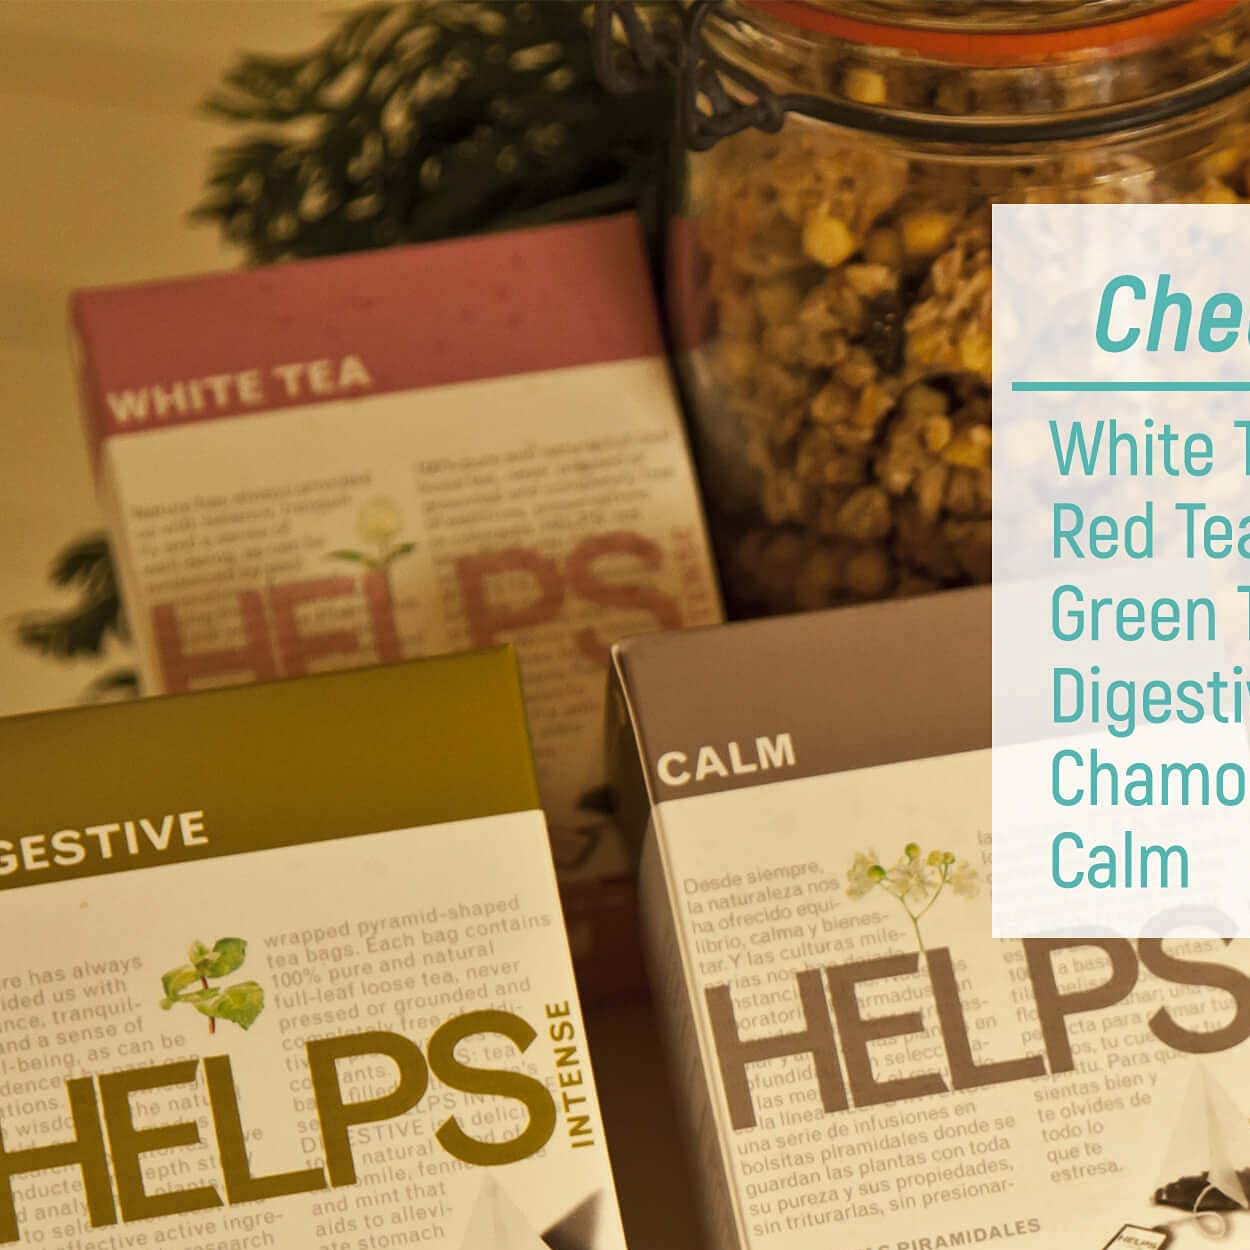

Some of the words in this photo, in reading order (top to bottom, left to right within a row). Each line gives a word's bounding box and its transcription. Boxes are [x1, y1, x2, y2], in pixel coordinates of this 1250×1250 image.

[107, 374, 263, 426] WHITE
[275, 355, 374, 396] TEA
[656, 734, 796, 789] CALM
[683, 872, 743, 895] Desde
[747, 861, 824, 884] siempre,
[708, 885, 803, 913] naturaleza
[808, 879, 841, 893] nos
[263, 920, 350, 953] wrapped
[358, 895, 521, 938] pyramid-shaped
[696, 936, 746, 955] librio,
[750, 925, 802, 946] calma
[822, 911, 889, 934] bienes-
[718, 906, 792, 931] ofrecido
[796, 898, 841, 920] equi-
[267, 950, 299, 969] tea
[306, 940, 360, 964] bags.
[366, 929, 415, 953] Each
[422, 922, 459, 945] bag
[465, 912, 552, 939] contains
[748, 950, 774, 967] las
[779, 937, 853, 962] culturas
[860, 926, 907, 947] mile-
[28, 967, 66, 985] has
[72, 955, 143, 980] always
[272, 965, 321, 990] 100%
[329, 962, 373, 983] pure
[379, 952, 416, 974] and
[423, 940, 495, 966] natural
[53, 988, 76, 1004] us
[83, 977, 128, 998] with
[274, 982, 355, 1010] full-leaf
[361, 974, 416, 997] loose
[422, 968, 458, 987] tea,
[466, 958, 522, 980] never
[52, 996, 143, 1026] tranquil-
[279, 1002, 360, 1034] pressed
[367, 1001, 386, 1017] or
[394, 987, 488, 1016] grounded
[495, 977, 532, 997] and
[1100, 1013, 1142, 1033] para
[55, 1022, 118, 1046] sense
[124, 1015, 143, 1034] of
[87, 1046, 111, 1062] as
[117, 1038, 154, 1057] can
[161, 1031, 186, 1050] be
[545, 1000, 596, 1150] INTENSE
[1107, 1051, 1151, 1070] Para
[1033, 1080, 1100, 1103] sientas
[1104, 1072, 1145, 1092] bien
[0, 1008, 557, 1244] HELPS
[1060, 1096, 1126, 1119] olvides
[738, 1138, 771, 1155] una
[776, 1129, 822, 1148] serie
[854, 1107, 947, 1135] infusiones
[954, 1101, 976, 1117] en
[741, 1151, 816, 1177] bolsitas
[821, 1133, 927, 1164] piramidales
[934, 1117, 990, 1141] donde
[995, 1115, 1016, 1131] se
[1042, 1123, 1083, 1144] todo
[1088, 1120, 1104, 1136] lo
[745, 1171, 822, 1199] guardan
[826, 1165, 854, 1181] las
[859, 1152, 927, 1178] plantas
[931, 1145, 965, 1162] con
[969, 1137, 1011, 1157] toda
[1047, 1147, 1080, 1165] que
[1084, 1142, 1102, 1157] te
[1050, 1160, 1124, 1183] estresa.
[312, 1196, 351, 1218] and
[356, 1187, 401, 1210] mint
[406, 1180, 446, 1202] that
[750, 1200, 771, 1217] su
[777, 1188, 840, 1215] pureza
[859, 1179, 891, 1197] sus
[896, 1159, 1015, 1190] propiedades,
[315, 1214, 357, 1238] aids
[364, 1212, 384, 1229] to
[391, 1204, 453, 1226] allevi-
[753, 1219, 782, 1237] sin
[787, 1201, 884, 1230] triturarlas,
[889, 1196, 916, 1213] sin
[922, 1178, 1015, 1208] presionar-
[154, 1219, 217, 1245] active
[223, 1208, 284, 1234] ingre-
